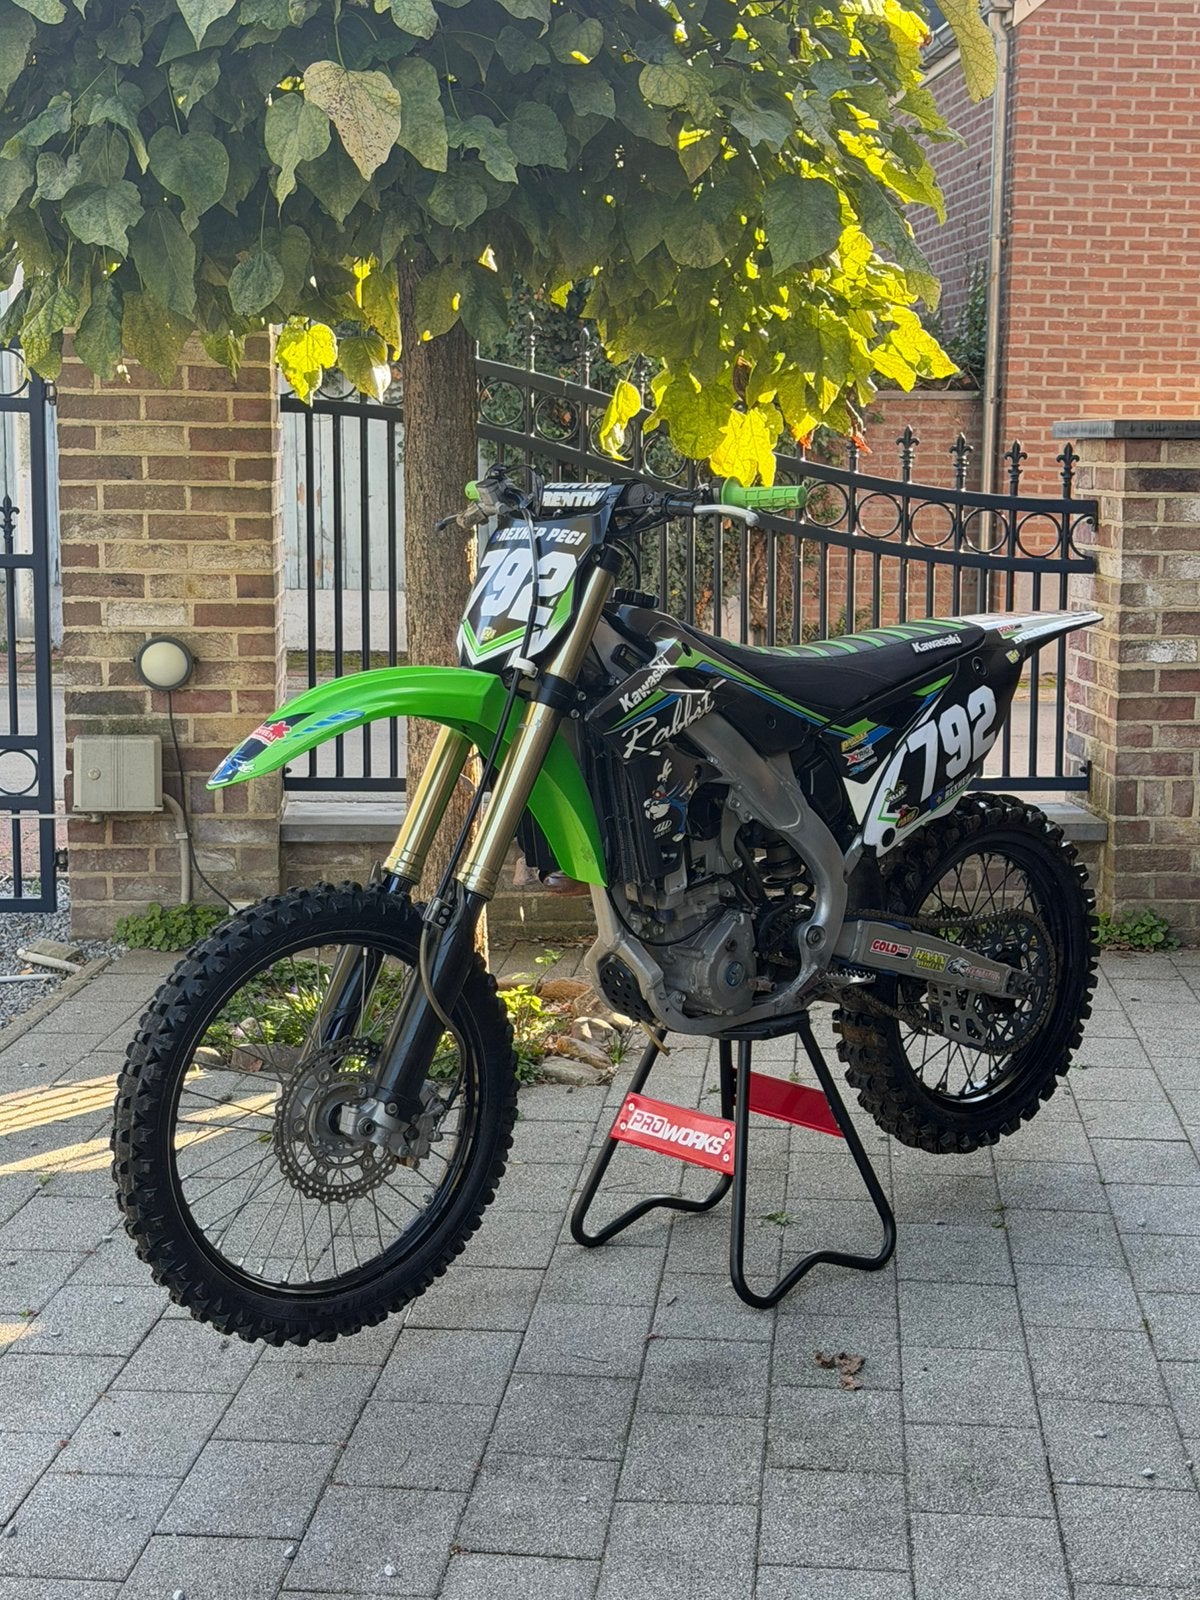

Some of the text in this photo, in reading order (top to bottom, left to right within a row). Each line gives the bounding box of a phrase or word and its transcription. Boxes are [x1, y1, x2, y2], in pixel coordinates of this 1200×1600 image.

[498, 526, 547, 541] REXHP
[463, 547, 578, 626] 792
[911, 633, 962, 653] Kawasaki
[618, 653, 672, 713] Kawasaki
[621, 679, 726, 759] Rabbit
[906, 685, 997, 803] 792
[873, 940, 898, 953] GOLD
